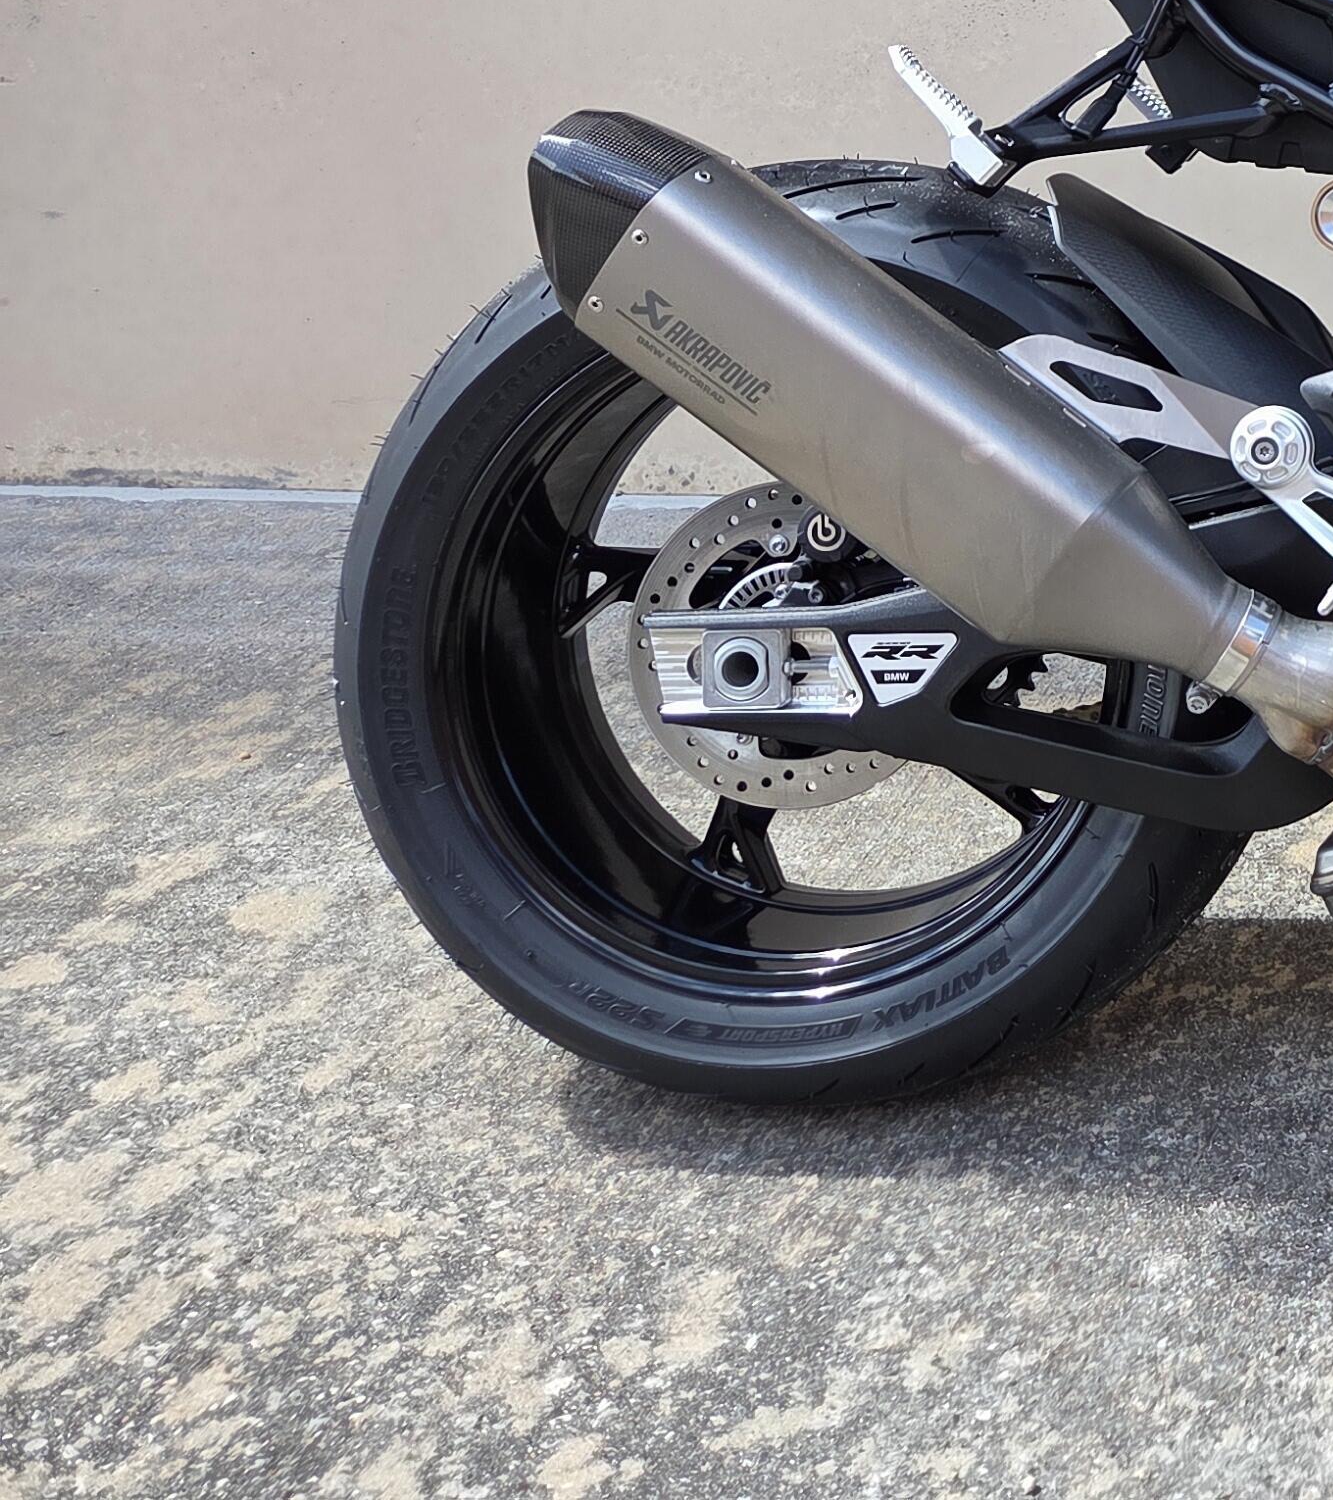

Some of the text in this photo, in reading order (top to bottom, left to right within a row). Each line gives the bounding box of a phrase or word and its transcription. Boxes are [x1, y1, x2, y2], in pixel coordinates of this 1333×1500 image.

[665, 356, 726, 405] MOTORRAD
[862, 644, 945, 661] RR
[883, 672, 910, 682] BMW
[872, 946, 1011, 1034] BATTLAX
